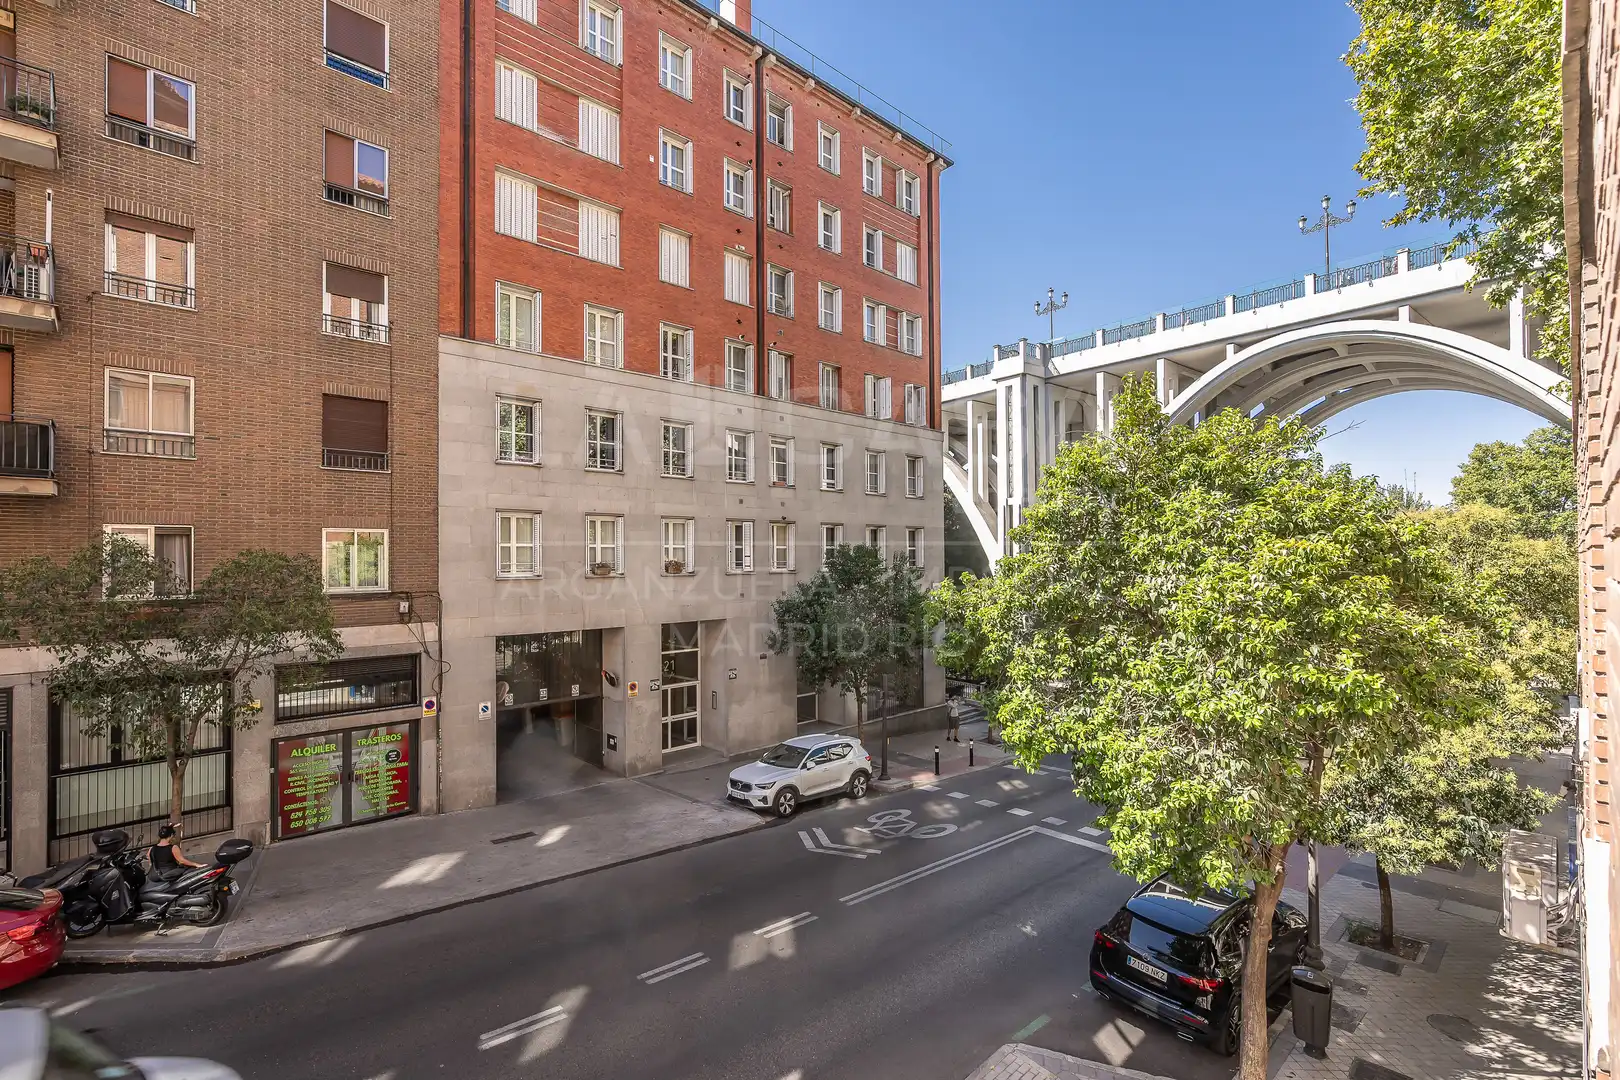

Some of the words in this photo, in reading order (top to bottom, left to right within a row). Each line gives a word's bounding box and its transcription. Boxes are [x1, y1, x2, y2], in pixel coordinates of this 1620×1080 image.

[663, 659, 675, 672] 21
[357, 733, 402, 746] TRASTEROS
[291, 744, 336, 757] ALQUILER
[1150, 967, 1165, 980] NKZ
